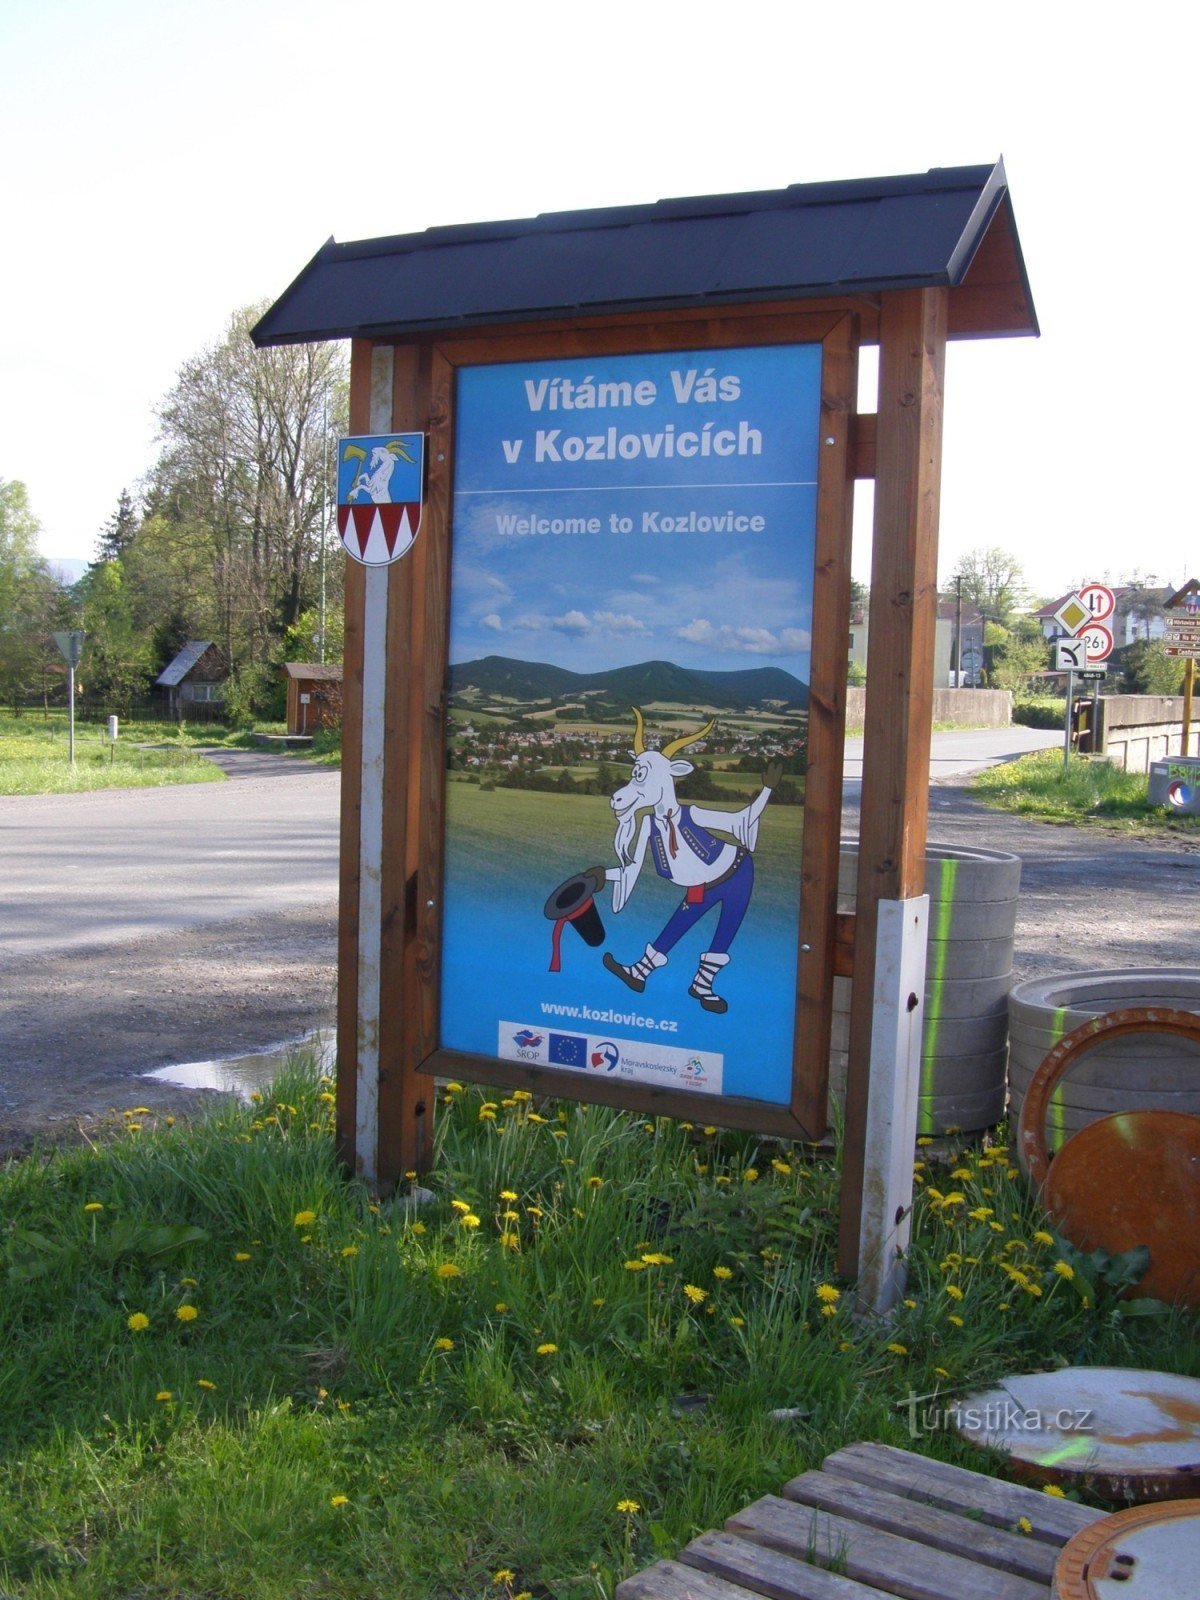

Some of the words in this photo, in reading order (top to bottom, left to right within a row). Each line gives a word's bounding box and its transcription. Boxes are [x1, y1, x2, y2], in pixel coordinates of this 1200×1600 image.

[524, 375, 657, 412] Vítáme
[670, 367, 742, 404] Vás
[502, 438, 523, 464] v
[534, 420, 763, 463] Kozlovicích
[495, 513, 601, 536] Welcome
[609, 513, 634, 534] to
[641, 510, 766, 533] Kozlovice
[1085, 635, 1100, 649] 26
[540, 1002, 679, 1033] www.kozlovice.cz
[515, 1048, 541, 1061] SROP
[621, 1057, 678, 1075] Moravskoslezský
[621, 1066, 634, 1076] kraj
